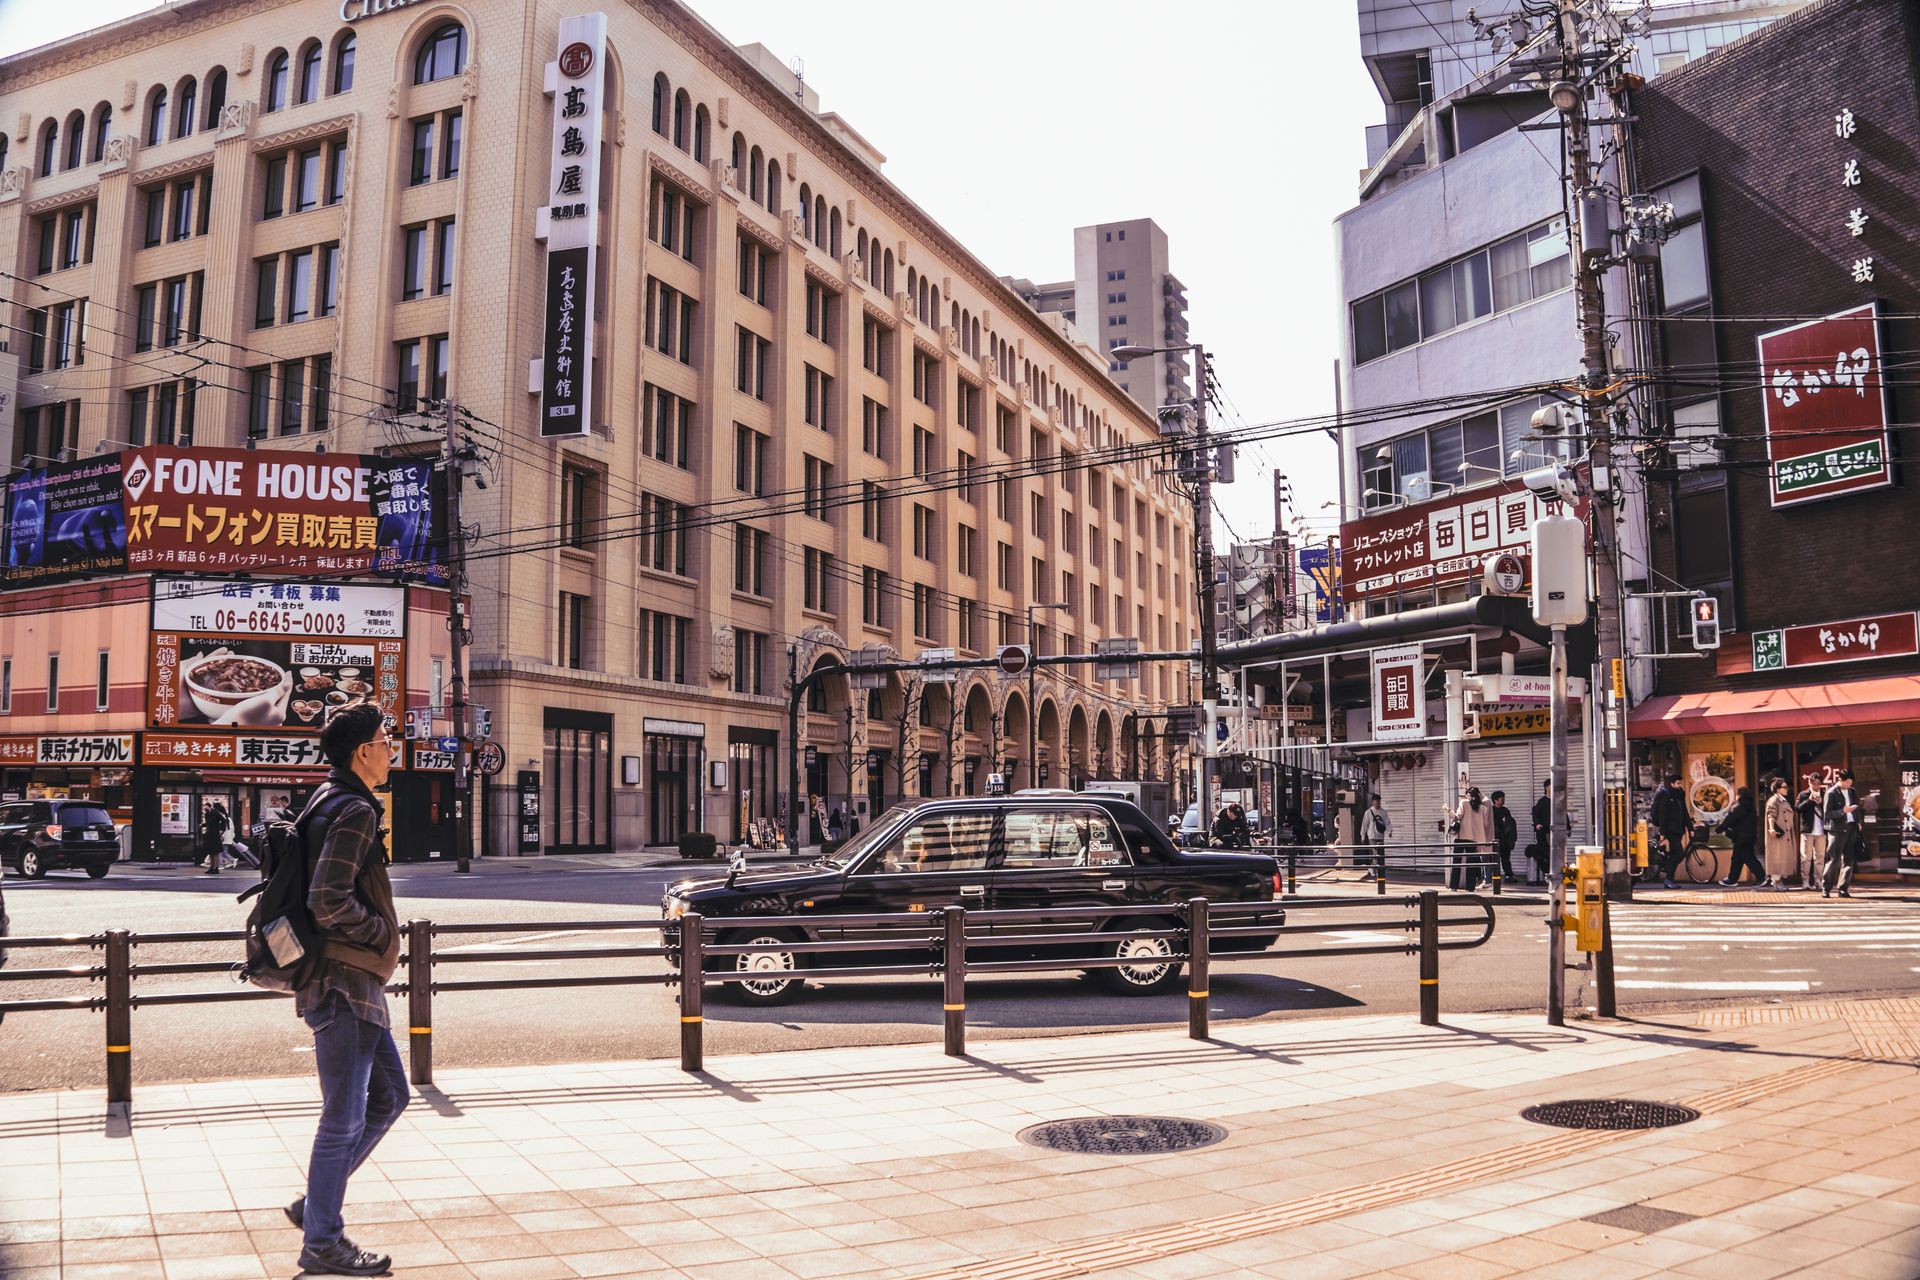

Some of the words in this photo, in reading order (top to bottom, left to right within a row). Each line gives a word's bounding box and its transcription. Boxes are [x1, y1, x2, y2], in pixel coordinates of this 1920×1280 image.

[1835, 108, 1874, 283] 浪花善哉
[1772, 347, 1870, 408] なか卯
[154, 458, 243, 496] FONE
[257, 462, 372, 502] HOUSE
[374, 467, 418, 485] 大阪で
[376, 482, 430, 498] 一番高く
[377, 498, 431, 516] 買取しま
[127, 503, 378, 549] スマートフォン買取売買
[1353, 519, 1424, 551] リユースショップ
[379, 546, 402, 559] TEL
[1353, 541, 1424, 572] アウトレット店
[223, 582, 301, 600] 広告・看板
[309, 585, 341, 602] 募集
[257, 601, 304, 610] お問い合わせ
[190, 615, 207, 630] TEL
[215, 609, 345, 635] 06-6645-0003
[367, 619, 391, 627] 有限会社
[1819, 622, 1879, 653] なか卯
[310, 644, 346, 655] ごはん
[309, 654, 372, 665] おかわり自由
[156, 648, 176, 724] 焼き牛丼
[381, 653, 399, 709] 唐揚げ
[1387, 675, 1407, 693] 毎日
[1387, 694, 1409, 711] 買取
[41, 738, 129, 762] 東京チカラめし
[173, 741, 232, 757] 焼き牛丼
[1822, 765, 1840, 784] 2F
